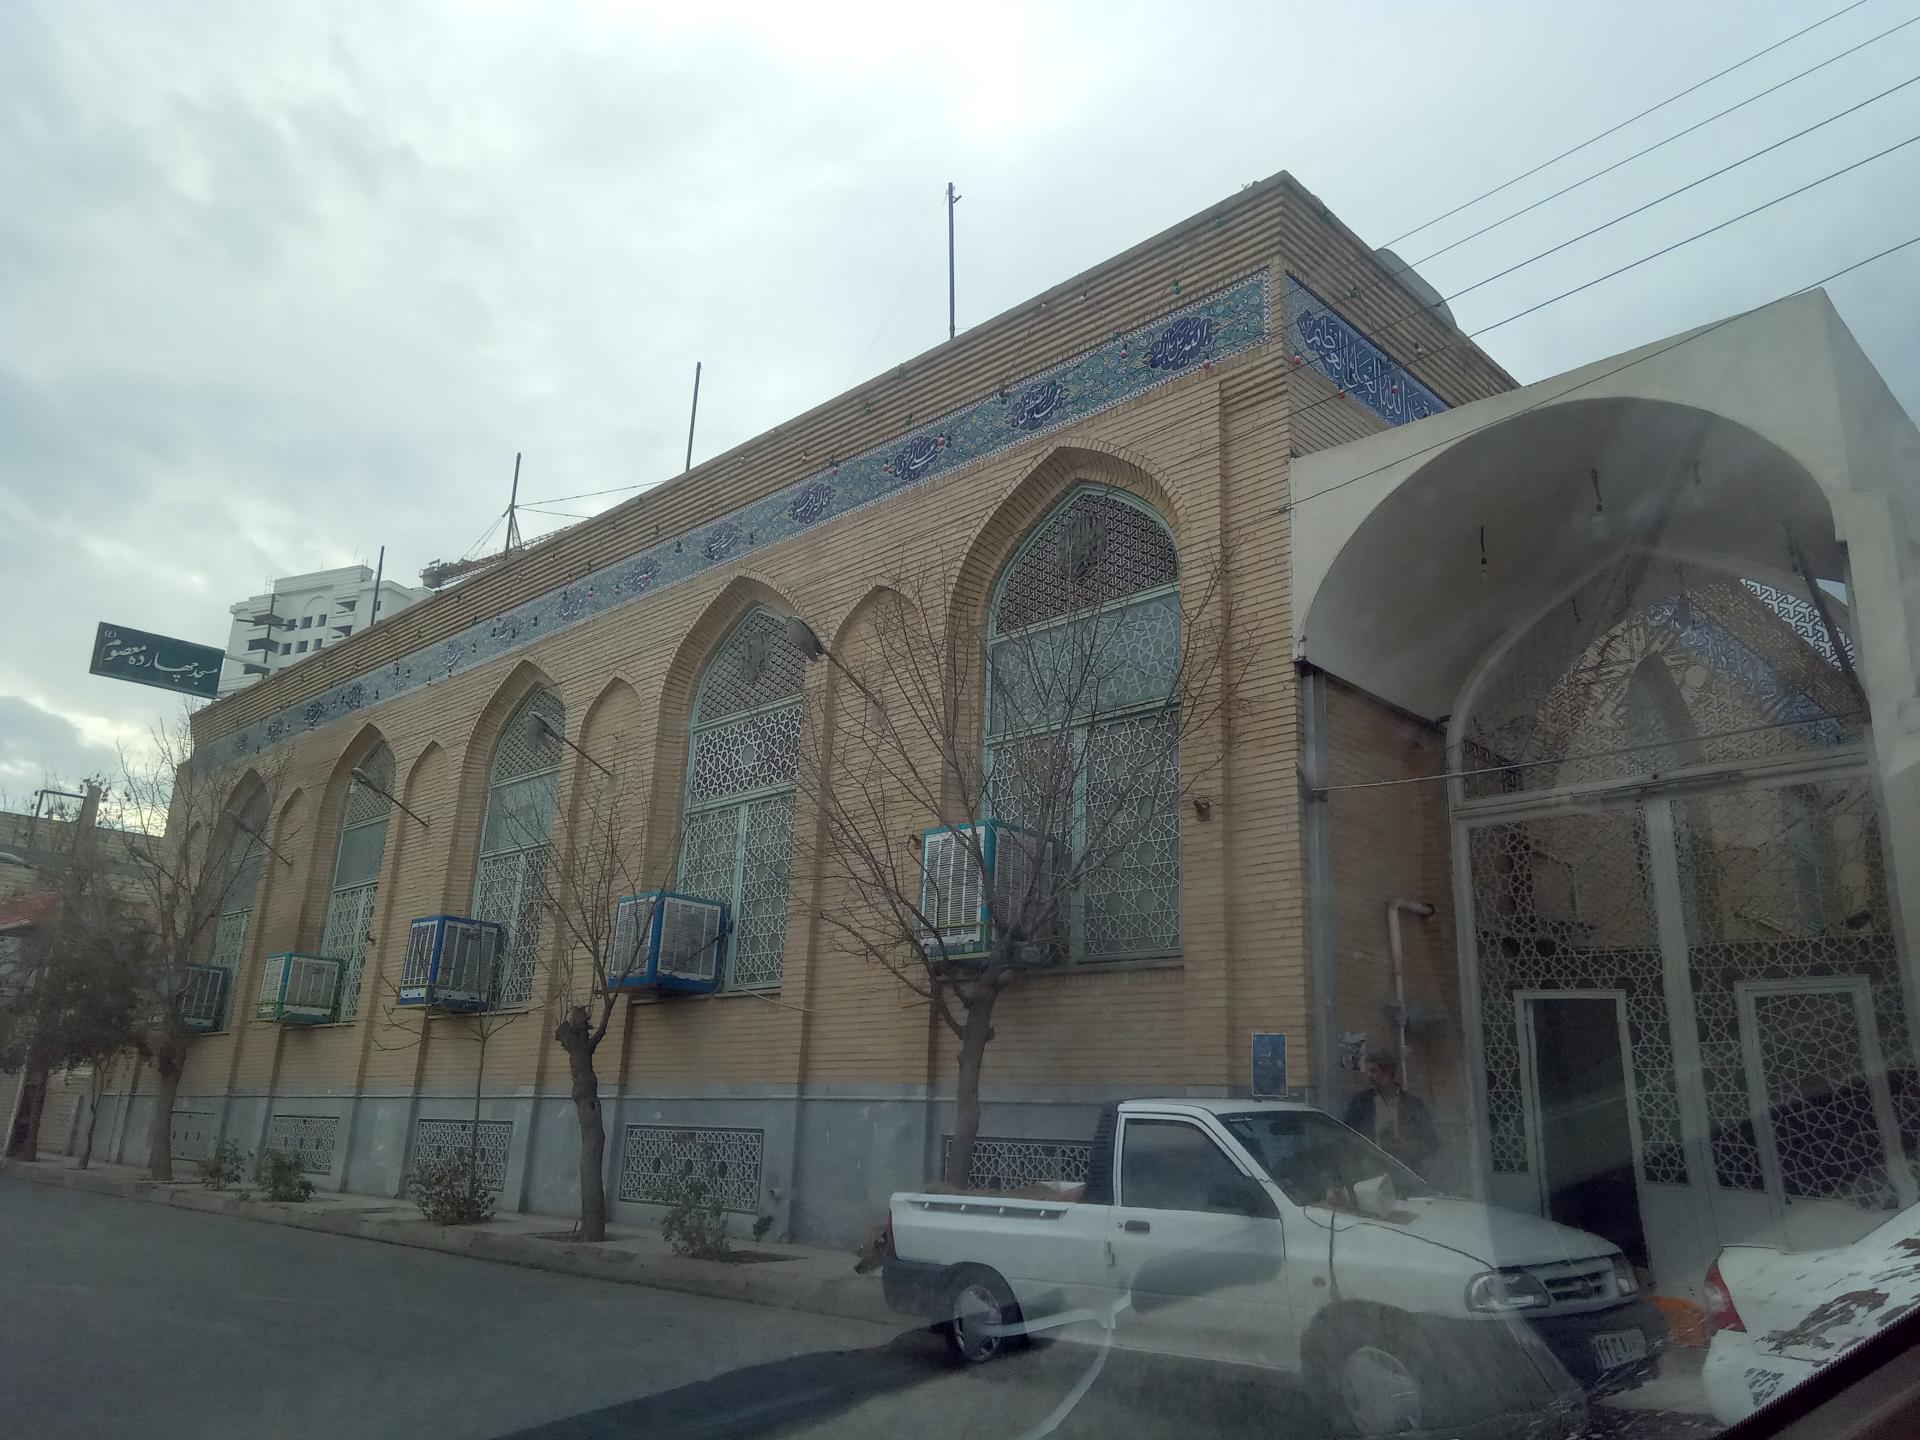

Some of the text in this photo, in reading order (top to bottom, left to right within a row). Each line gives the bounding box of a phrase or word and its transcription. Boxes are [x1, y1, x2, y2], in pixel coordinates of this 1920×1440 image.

[104, 639, 147, 661] معصوم
[128, 651, 200, 683] چهارده
[186, 667, 218, 685] مسجد
